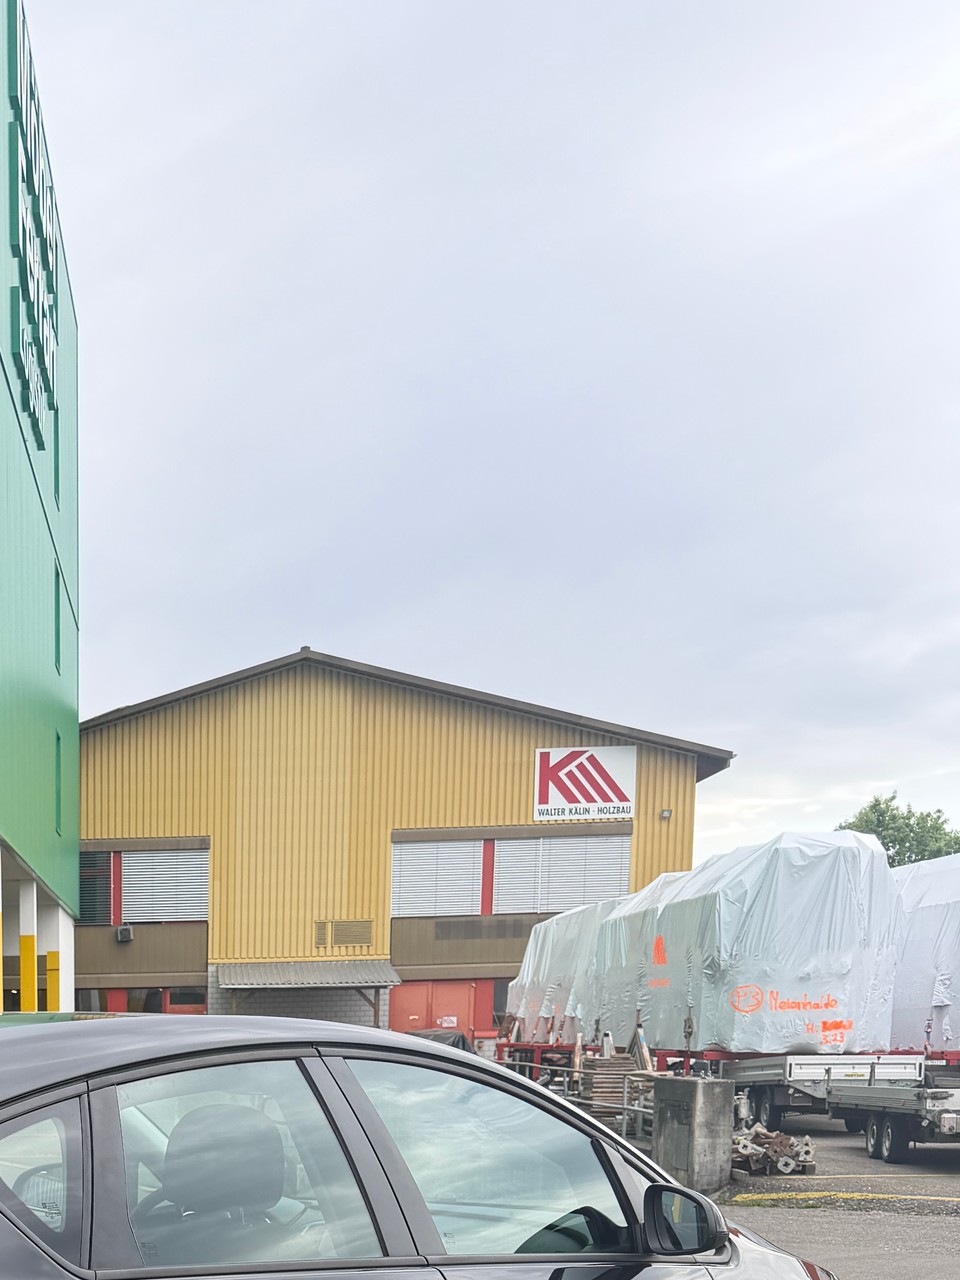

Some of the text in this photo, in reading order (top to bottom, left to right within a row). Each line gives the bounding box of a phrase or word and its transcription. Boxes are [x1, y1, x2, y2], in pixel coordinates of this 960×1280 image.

[17, 123, 57, 410] Ferrari
[538, 806, 632, 817] WALTER KÄLIN HOLZBAU
